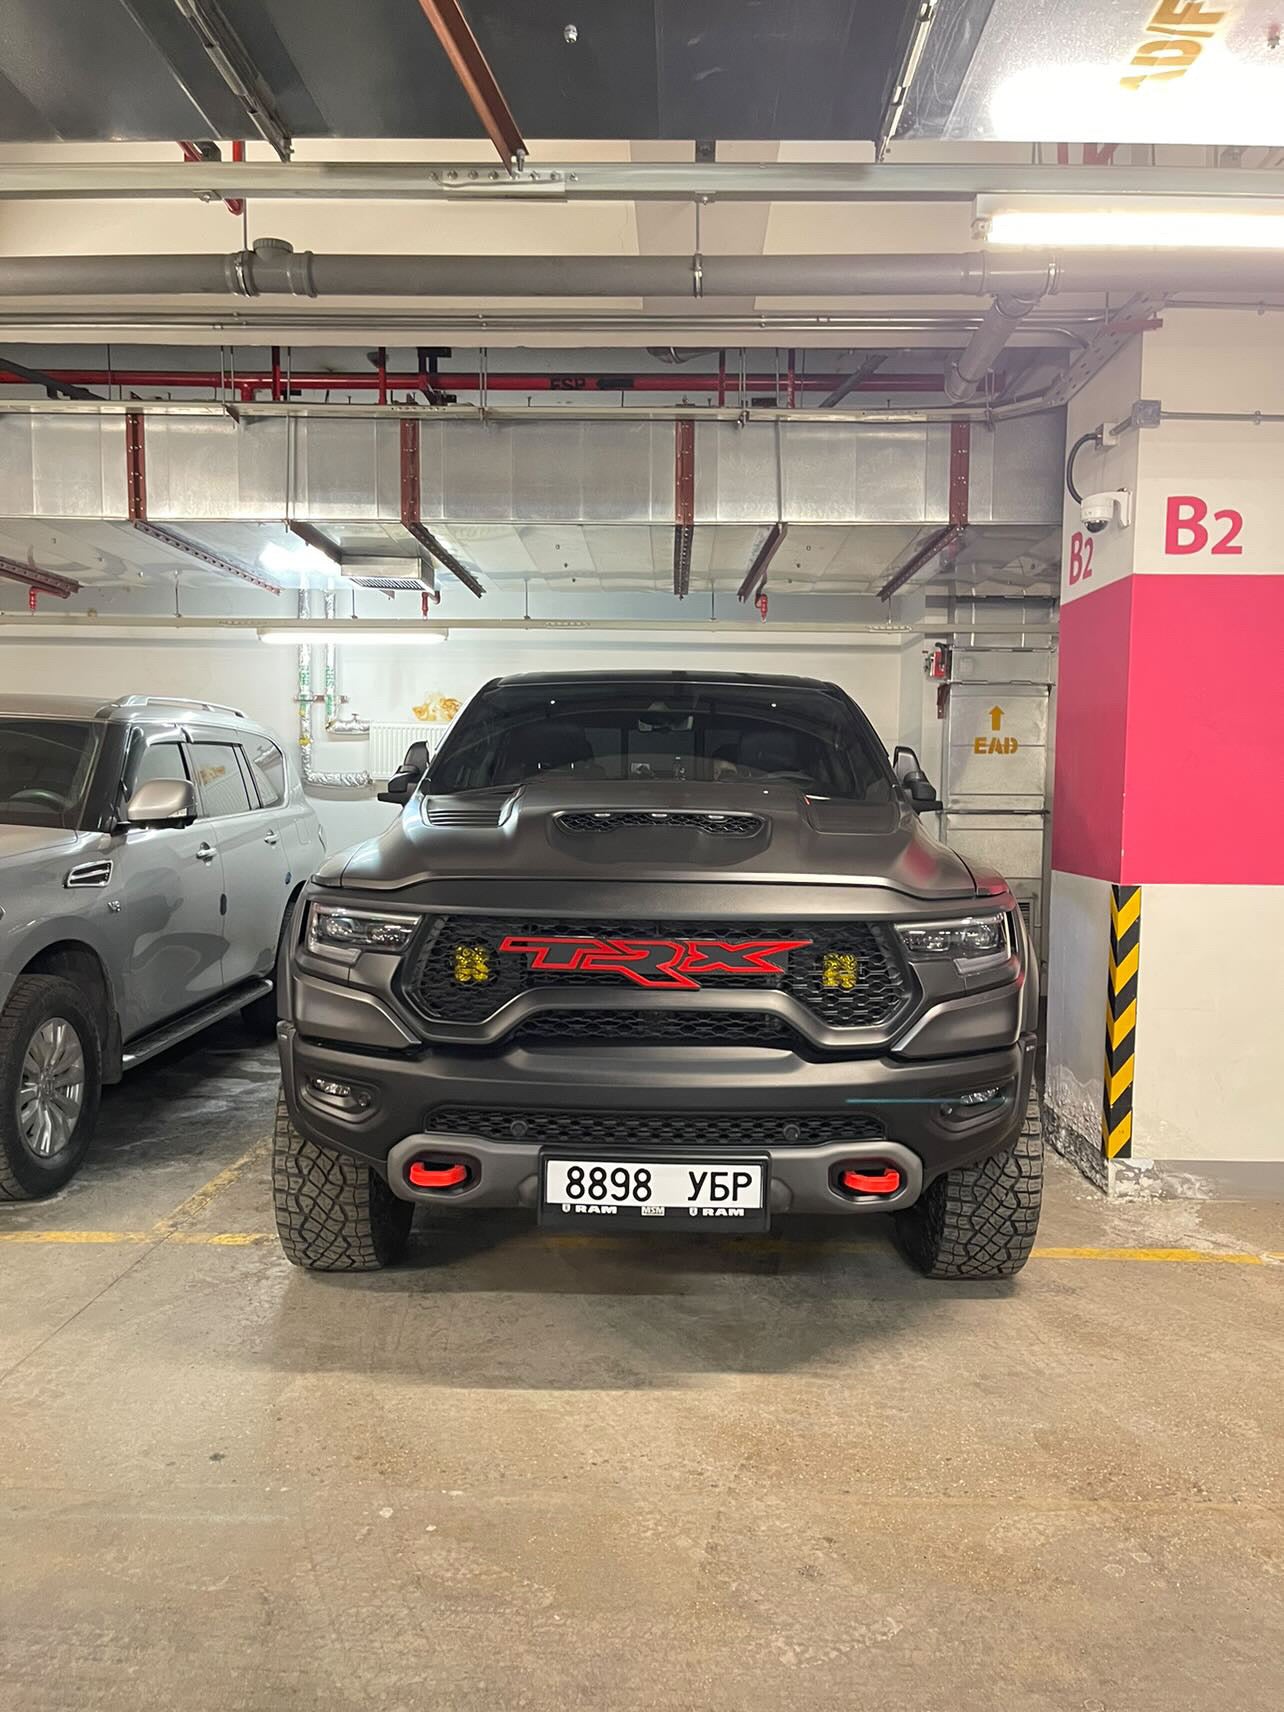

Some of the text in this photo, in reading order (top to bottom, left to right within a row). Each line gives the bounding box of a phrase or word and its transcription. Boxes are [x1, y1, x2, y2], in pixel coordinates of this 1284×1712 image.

[1165, 496, 1243, 555] B2
[1069, 531, 1094, 586] B2
[973, 737, 1018, 754] EAD
[500, 936, 813, 991] TRX
[566, 1166, 752, 1202] 8898 УБР
[575, 1204, 618, 1214] RAM
[702, 1208, 745, 1217] RAM
